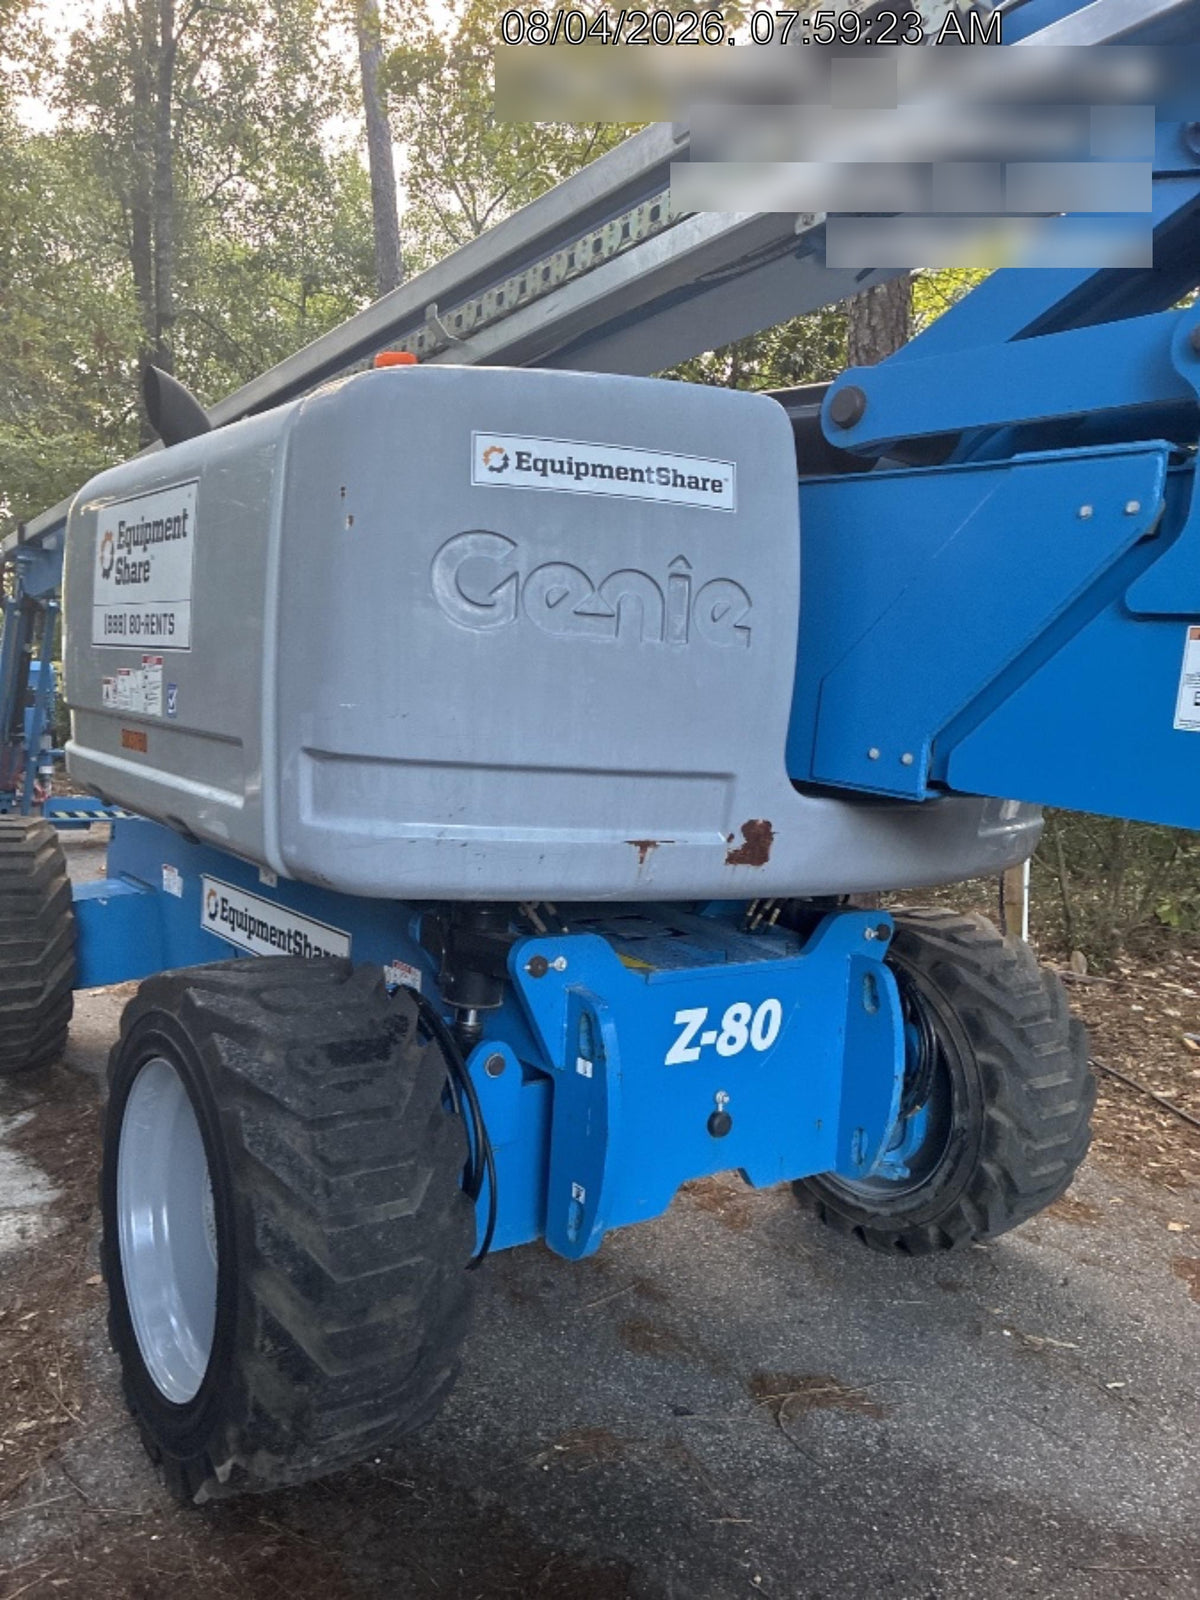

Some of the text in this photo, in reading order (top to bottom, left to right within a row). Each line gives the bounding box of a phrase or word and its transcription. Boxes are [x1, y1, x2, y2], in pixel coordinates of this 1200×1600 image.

[514, 451, 723, 494] EquipmentShare
[116, 508, 189, 556] Equipment
[115, 557, 151, 586] Share
[129, 612, 175, 637] 80-RENTS
[219, 897, 339, 958] EquipmentSha
[664, 998, 782, 1066] Z-80
